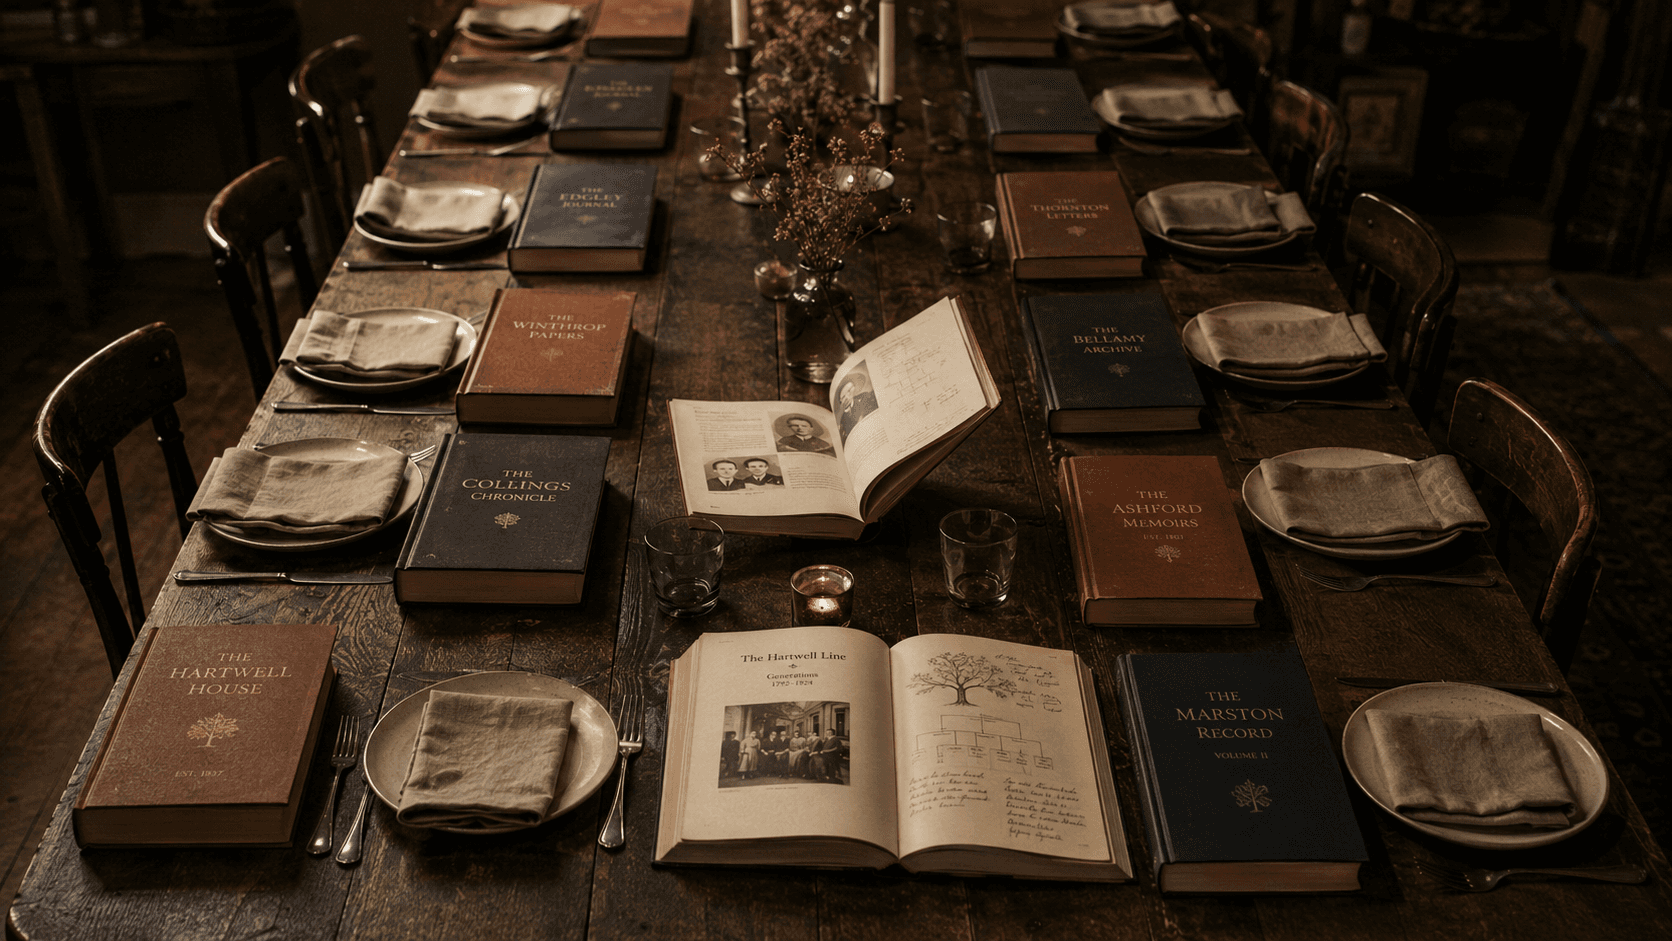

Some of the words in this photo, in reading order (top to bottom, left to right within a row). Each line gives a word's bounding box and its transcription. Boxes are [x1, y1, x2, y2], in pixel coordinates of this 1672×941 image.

[1030, 204, 1110, 212] THORNTON
[513, 321, 607, 331] WINTHROP
[1091, 326, 1119, 334] THE
[528, 331, 585, 339] PAPERS
[1073, 334, 1146, 344] BELLAMY
[1083, 345, 1143, 354] ARCHIVE
[502, 469, 534, 478] THE
[461, 478, 572, 491] COLLINGS
[470, 492, 557, 502] CHRONICLE
[1136, 490, 1169, 499] THE
[1112, 503, 1203, 514] ASHFORD
[1123, 518, 1199, 528] MEMOIRS
[218, 652, 253, 662] THE
[740, 654, 764, 662] The
[767, 651, 817, 661] Hartwell
[820, 651, 847, 661] Line
[169, 666, 292, 679] HARTWELL
[186, 683, 263, 695] HOUSE
[1205, 691, 1241, 702] THE
[1174, 707, 1285, 721] MARSTON
[1196, 726, 1273, 739] RECORD
[1214, 752, 1258, 760] VOLUME
[1260, 752, 1269, 760] II
